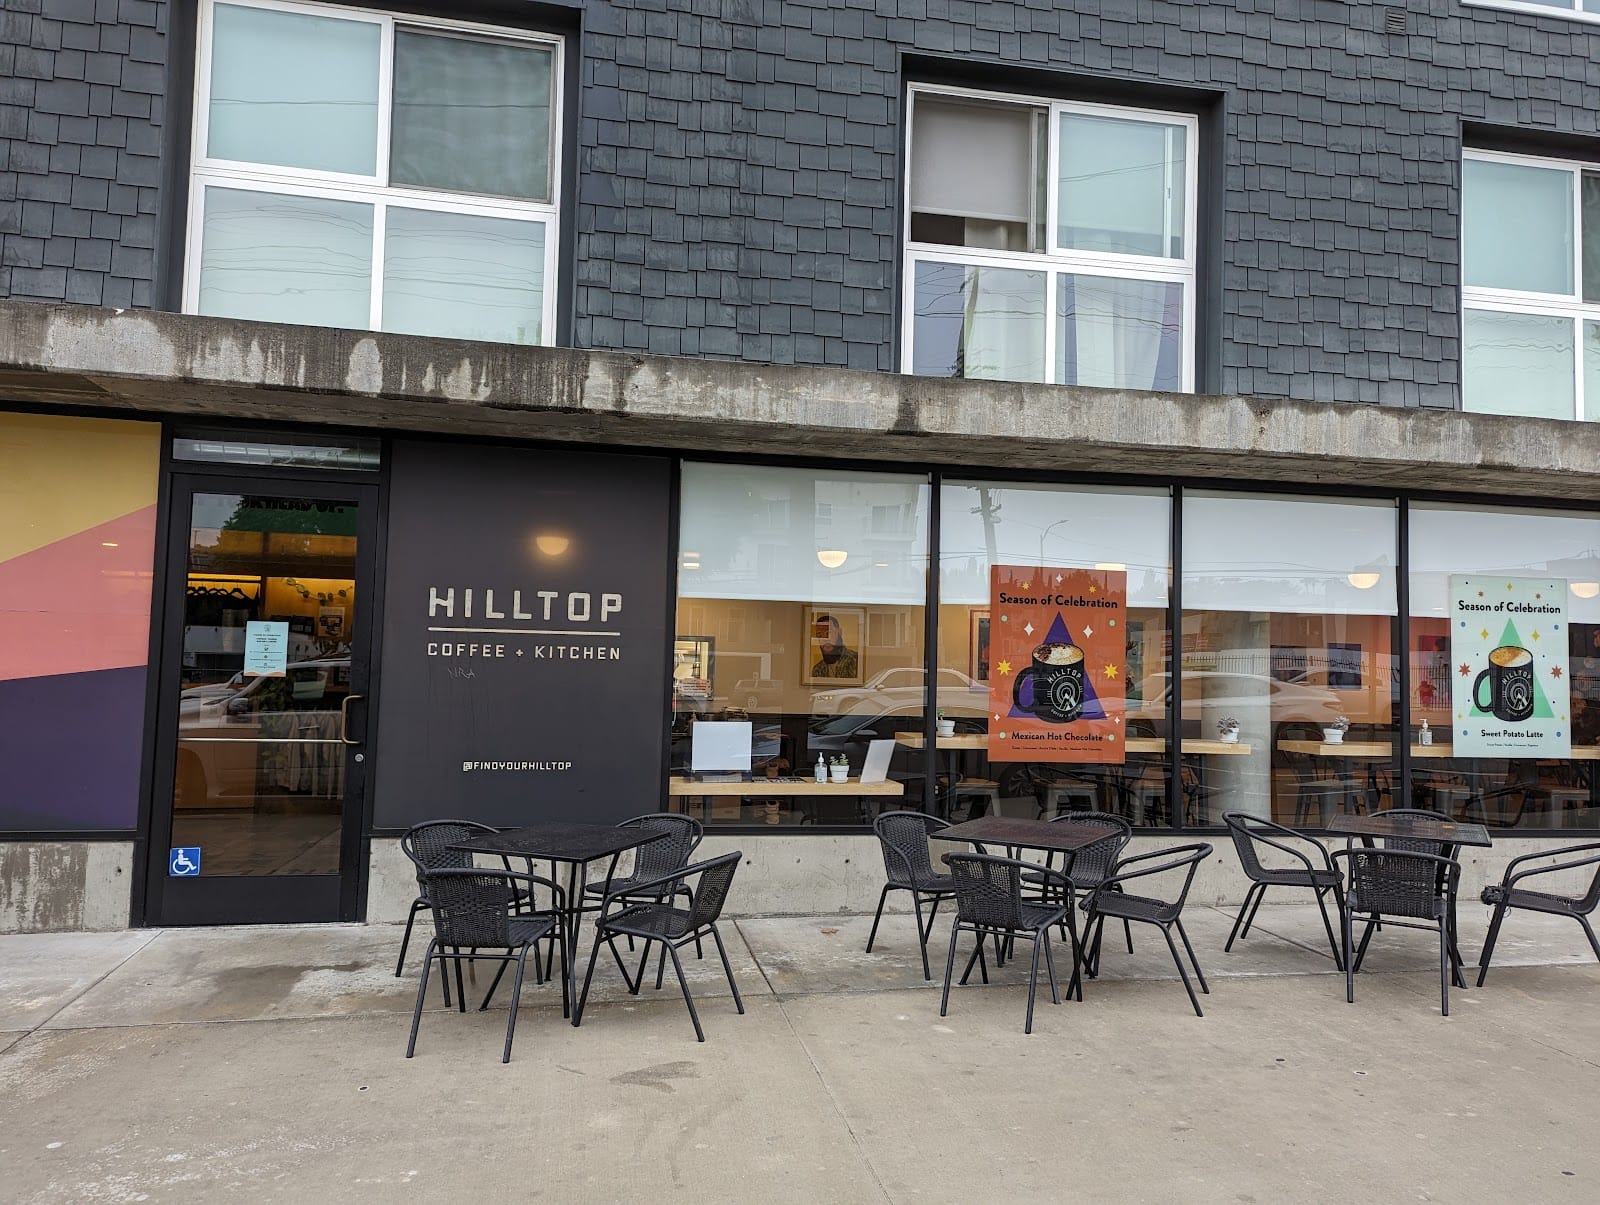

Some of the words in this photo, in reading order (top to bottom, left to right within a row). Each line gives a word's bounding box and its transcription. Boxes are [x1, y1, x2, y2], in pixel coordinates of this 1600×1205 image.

[428, 587, 622, 622] HILLTOP
[1000, 593, 1038, 605] Season
[1040, 594, 1053, 606] of
[1055, 595, 1118, 609] Celebration
[1458, 600, 1492, 612] Season
[1494, 601, 1505, 612] of
[1506, 602, 1561, 614] Celebration
[427, 642, 505, 658] COFFEE
[534, 645, 620, 660] KITCHEN
[1047, 668, 1082, 684] HILLTOP
[1011, 731, 1045, 741] Mexican
[1047, 732, 1062, 742] Hot
[1064, 732, 1103, 742] Chocolate
[1481, 729, 1501, 737] Sweet
[1503, 729, 1525, 738] Potato
[1526, 730, 1544, 738] Latte
[463, 761, 572, 771] @FINDYOURHILLTOP
